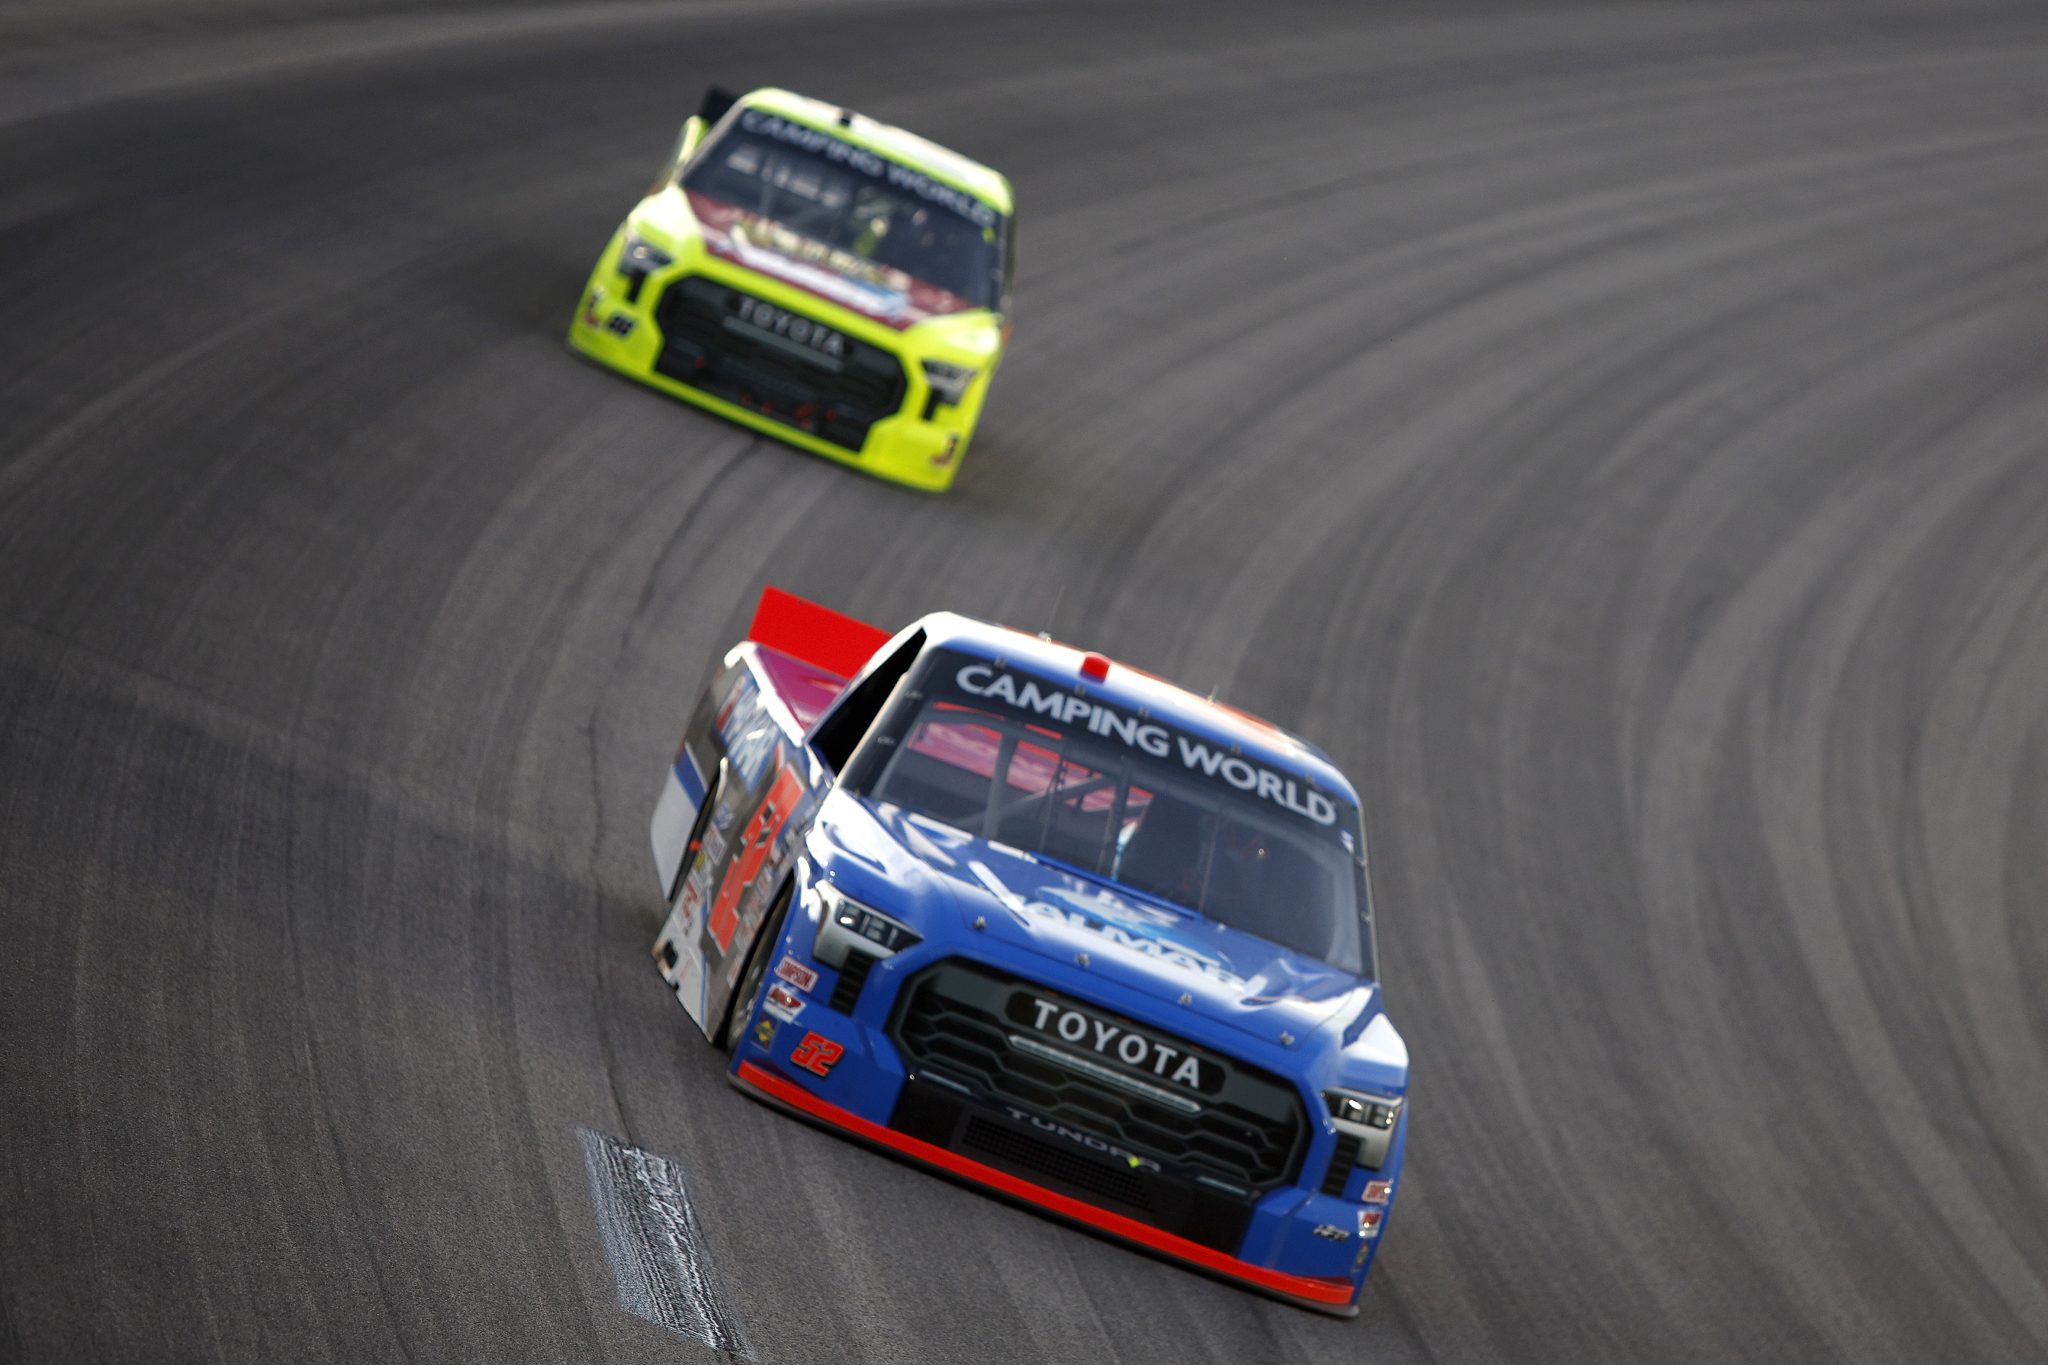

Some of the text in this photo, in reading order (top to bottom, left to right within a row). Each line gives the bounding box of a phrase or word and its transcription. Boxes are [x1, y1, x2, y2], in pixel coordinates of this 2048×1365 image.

[741, 109, 996, 228] CAMPING WORLD
[739, 296, 845, 356] TOYOTA
[954, 664, 1336, 826] CAMPING WORLD
[790, 1030, 844, 1077] 52
[1033, 998, 1200, 1089] TOYOTA
